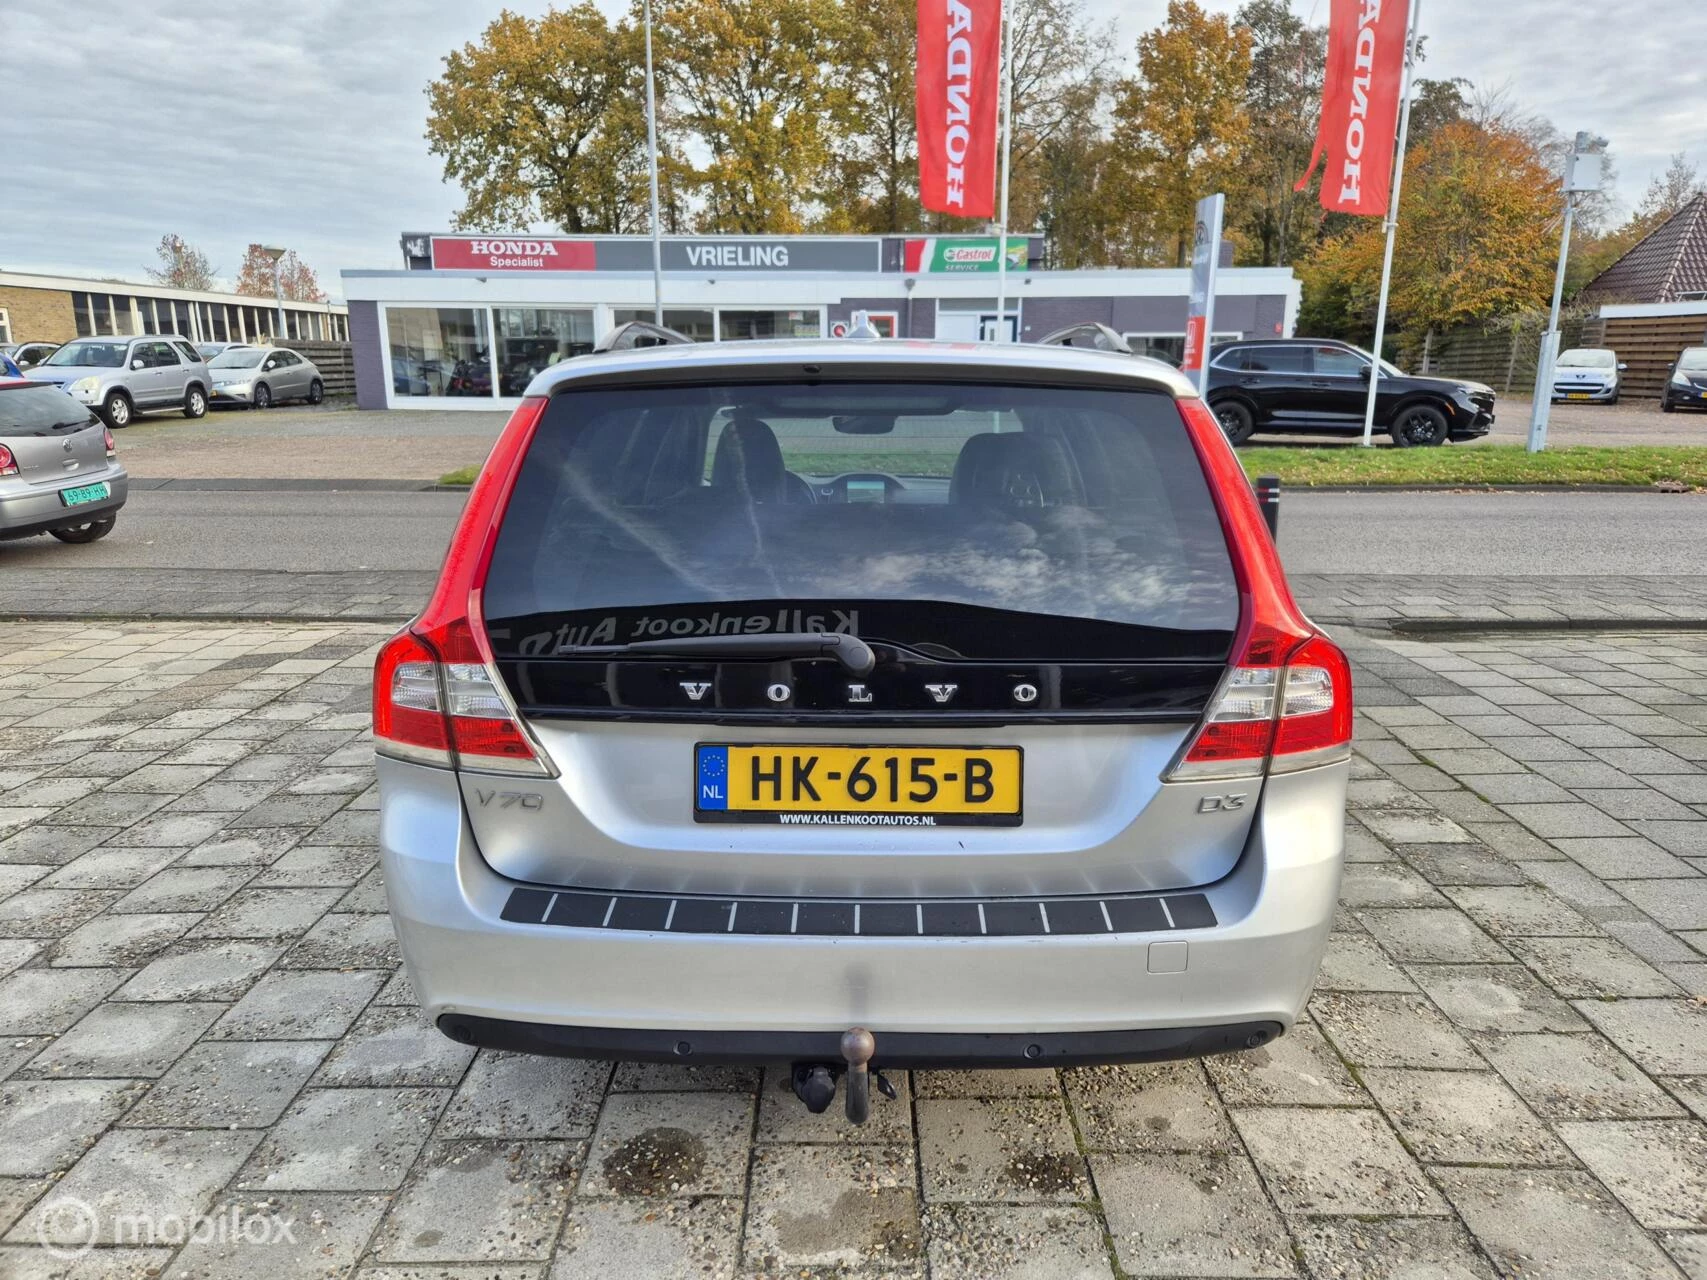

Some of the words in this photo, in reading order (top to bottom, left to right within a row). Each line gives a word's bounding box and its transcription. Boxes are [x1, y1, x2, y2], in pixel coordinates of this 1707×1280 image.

[470, 240, 558, 256] HONDA
[685, 245, 789, 267] VRIELING
[956, 249, 993, 260] Castrol
[490, 256, 544, 268] Specialist
[945, 264, 978, 272] SERVICE
[679, 682, 1038, 703] VOLVO
[702, 784, 724, 799] NL
[751, 755, 995, 804] HK-615-B
[474, 787, 545, 812] V70
[1196, 792, 1248, 814] D3
[779, 813, 937, 826] WWW.KALLENKOOTAUTOS.NL
